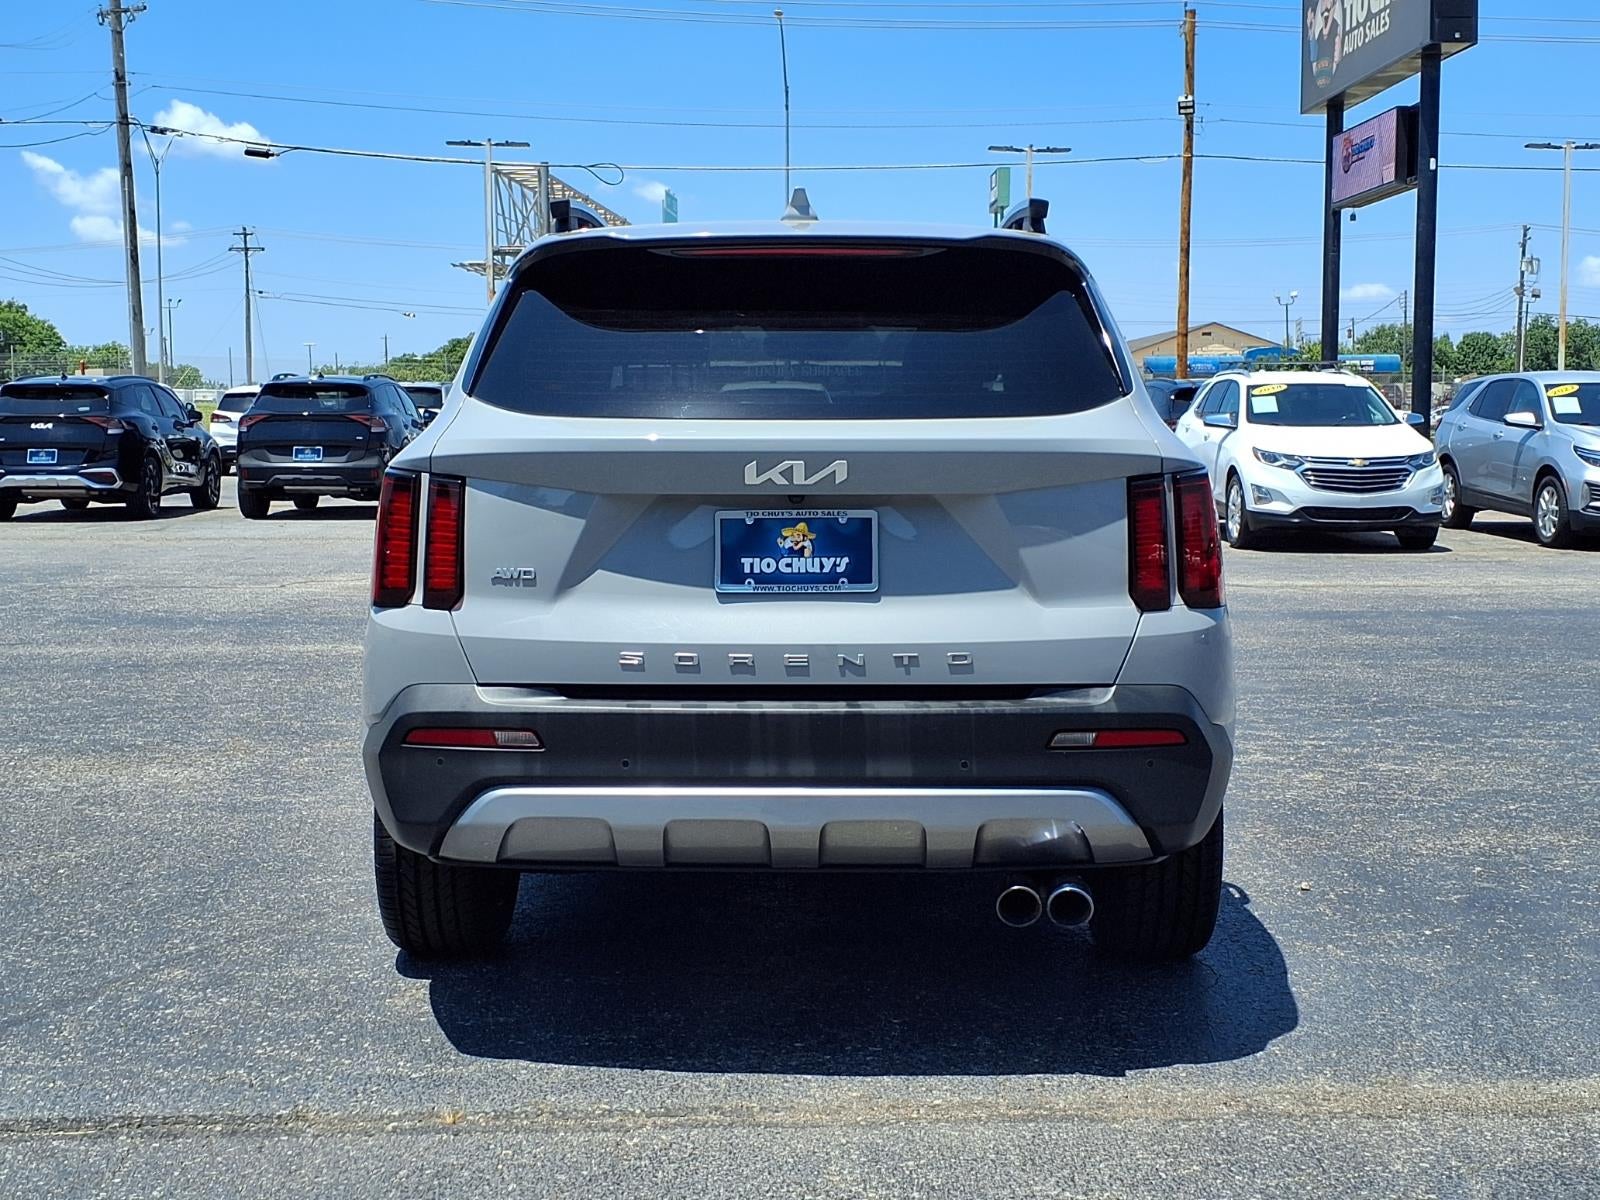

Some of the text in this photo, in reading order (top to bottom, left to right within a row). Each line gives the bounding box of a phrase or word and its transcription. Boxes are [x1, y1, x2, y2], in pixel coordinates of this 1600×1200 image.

[1343, 8, 1391, 56] AUTO SALES
[744, 459, 848, 485] KIA
[491, 567, 536, 580] AWD
[618, 650, 973, 668] SORENTO
